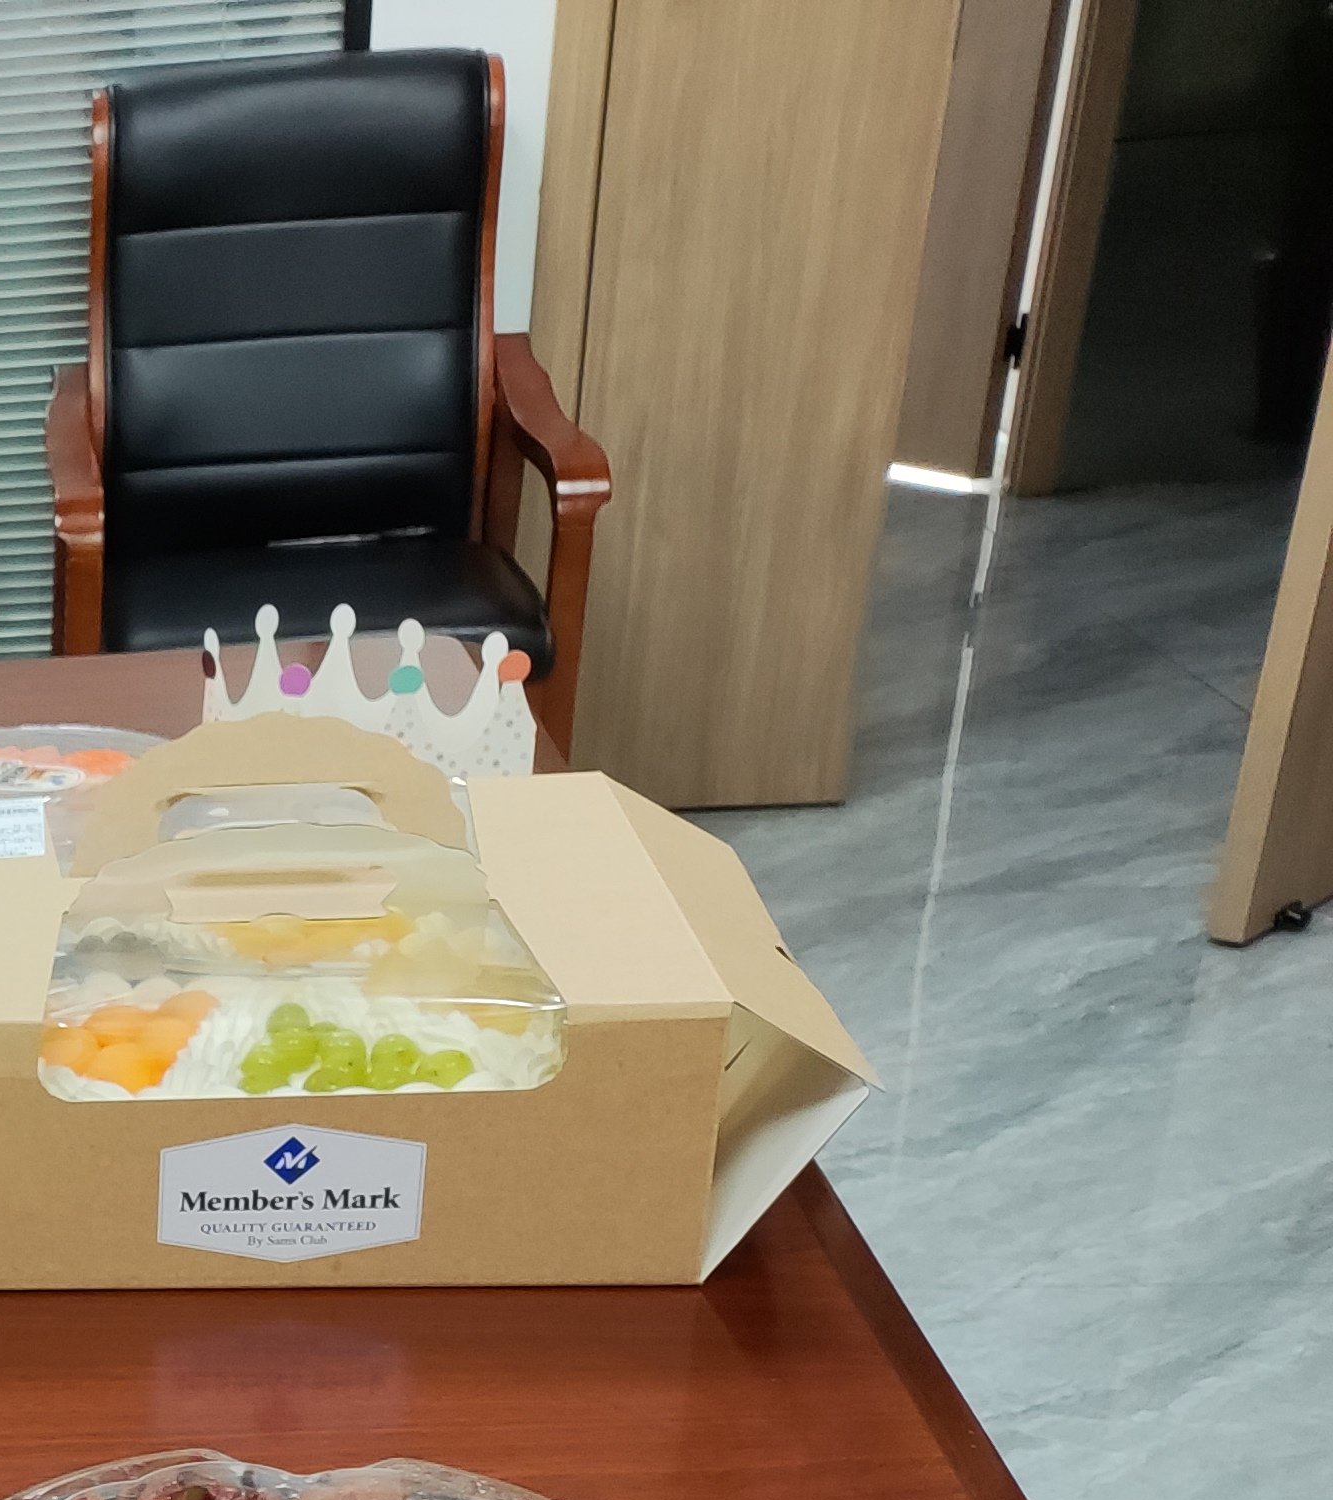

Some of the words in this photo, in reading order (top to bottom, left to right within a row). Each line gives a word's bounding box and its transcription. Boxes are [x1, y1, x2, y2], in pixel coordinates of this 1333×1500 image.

[179, 1189, 315, 1213] Member's
[322, 1186, 401, 1210] Mark
[199, 1222, 268, 1235] QUALITY
[271, 1220, 377, 1233] GUARANTEED
[247, 1235, 264, 1248] By
